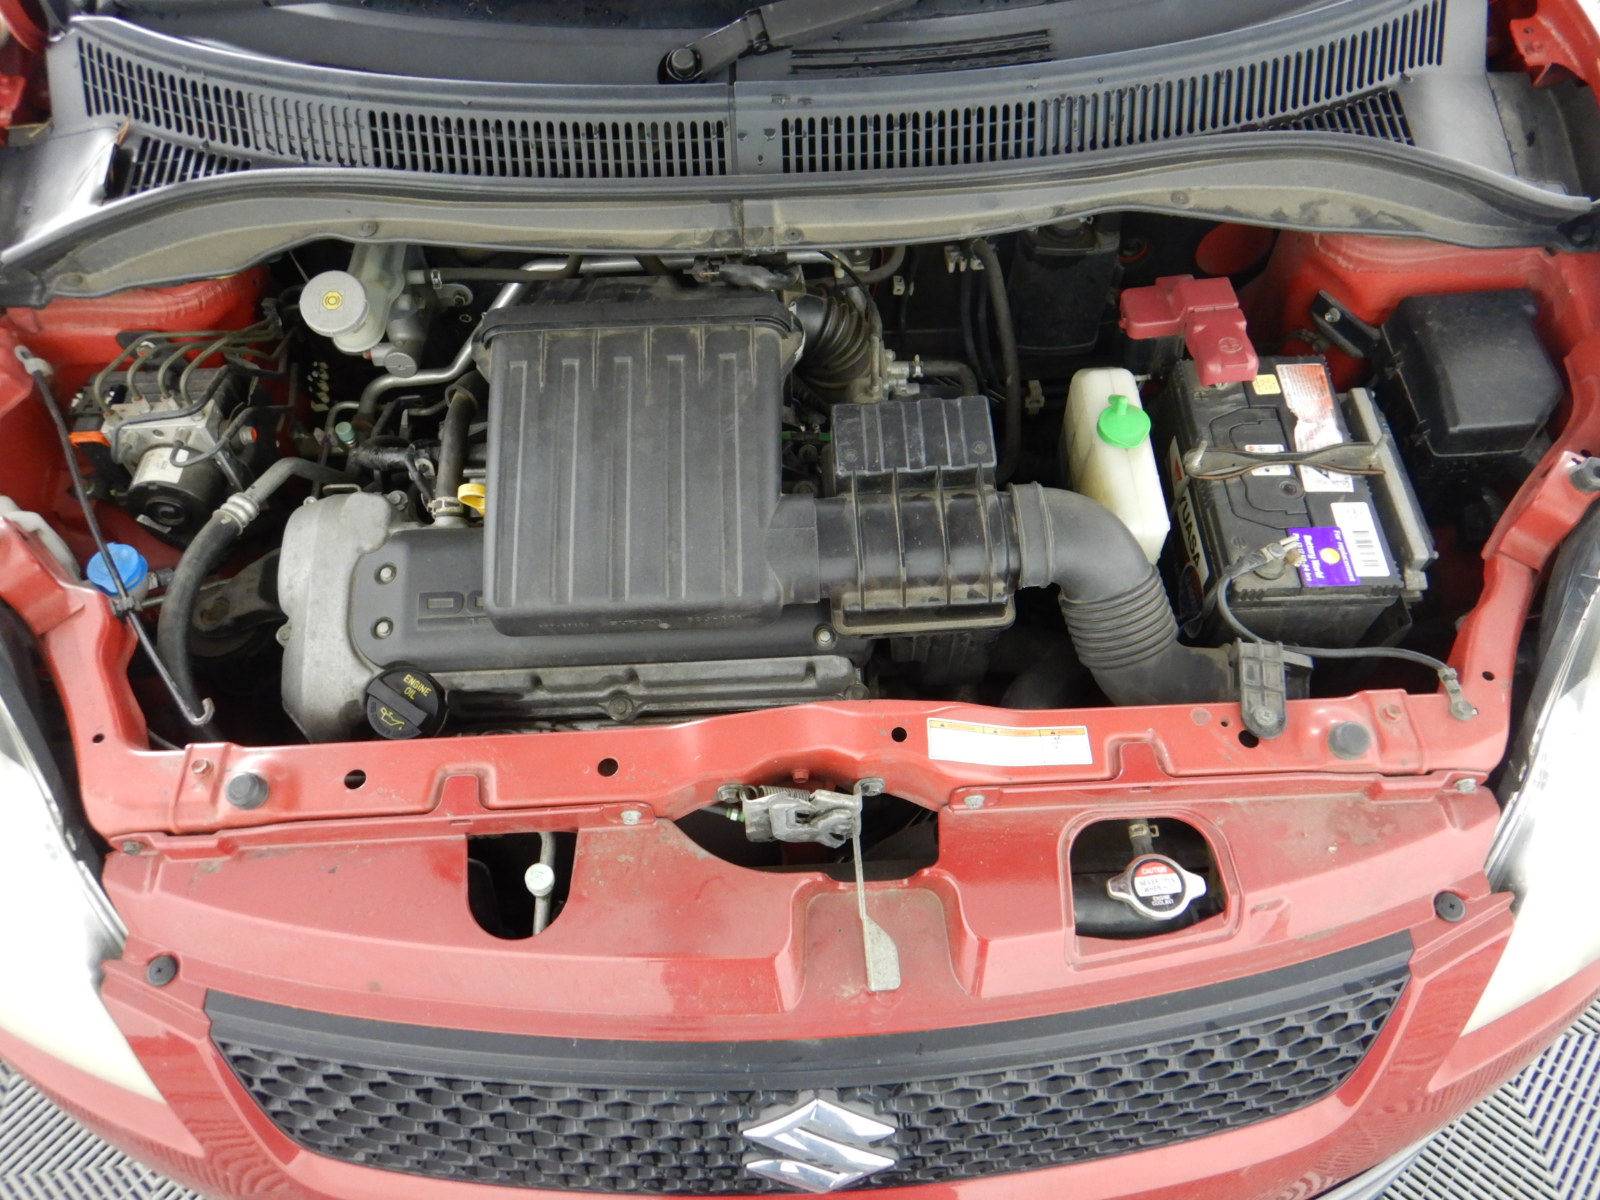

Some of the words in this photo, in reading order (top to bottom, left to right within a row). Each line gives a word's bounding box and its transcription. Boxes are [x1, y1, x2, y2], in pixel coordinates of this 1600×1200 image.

[1333, 530, 1342, 541] For
[1303, 534, 1318, 559] Battery
[1311, 559, 1326, 579] World
[1337, 541, 1356, 582] replacement
[403, 674, 432, 697] ENGINE
[404, 686, 417, 700] OIL
[1141, 866, 1168, 875] CAUTION
